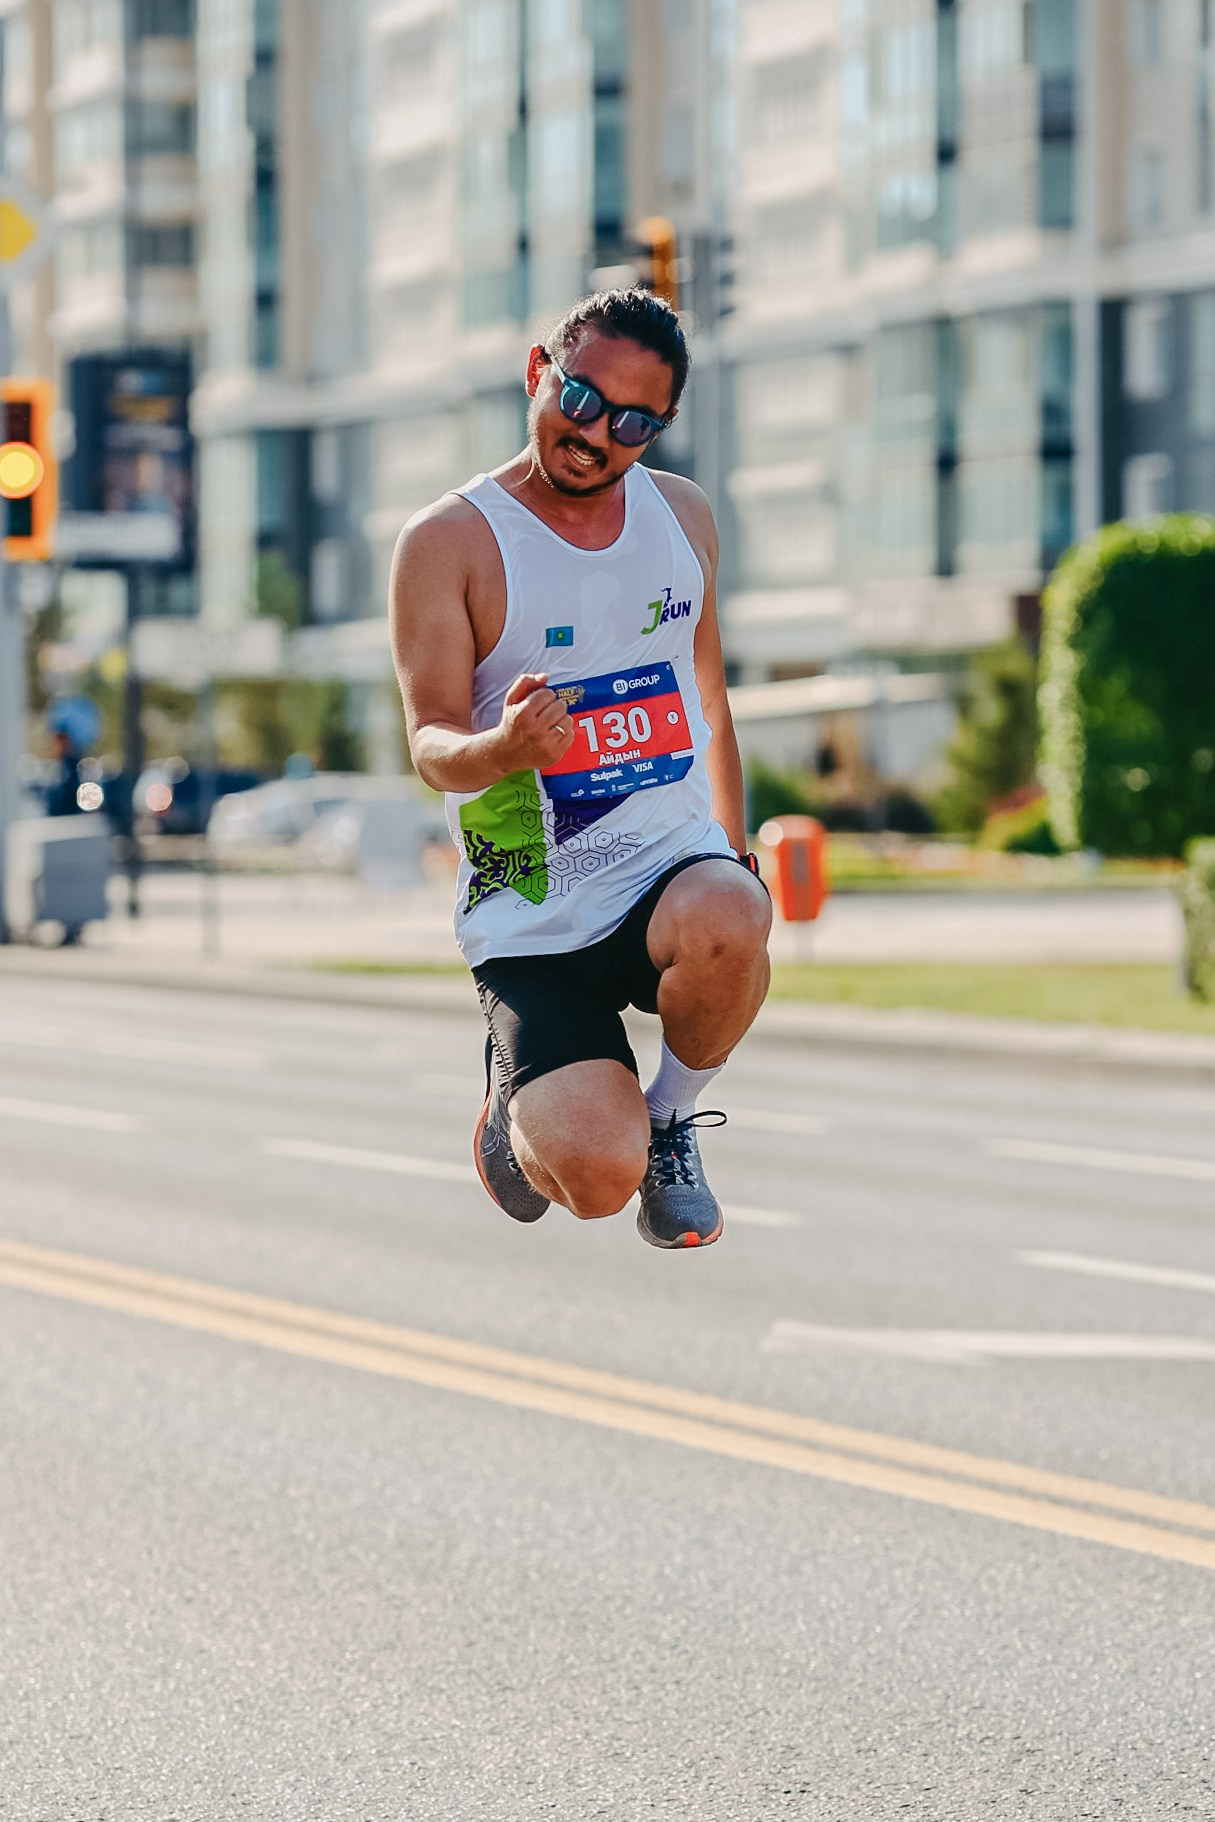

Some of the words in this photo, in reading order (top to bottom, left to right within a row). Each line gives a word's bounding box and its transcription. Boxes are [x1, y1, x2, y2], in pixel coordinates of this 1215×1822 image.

[614, 681, 627, 693] BI
[628, 674, 660, 689] GROUP
[578, 706, 652, 753] 130
[599, 749, 641, 766] Айдын
[590, 768, 623, 782] Sulpak
[632, 761, 654, 773] VISA
